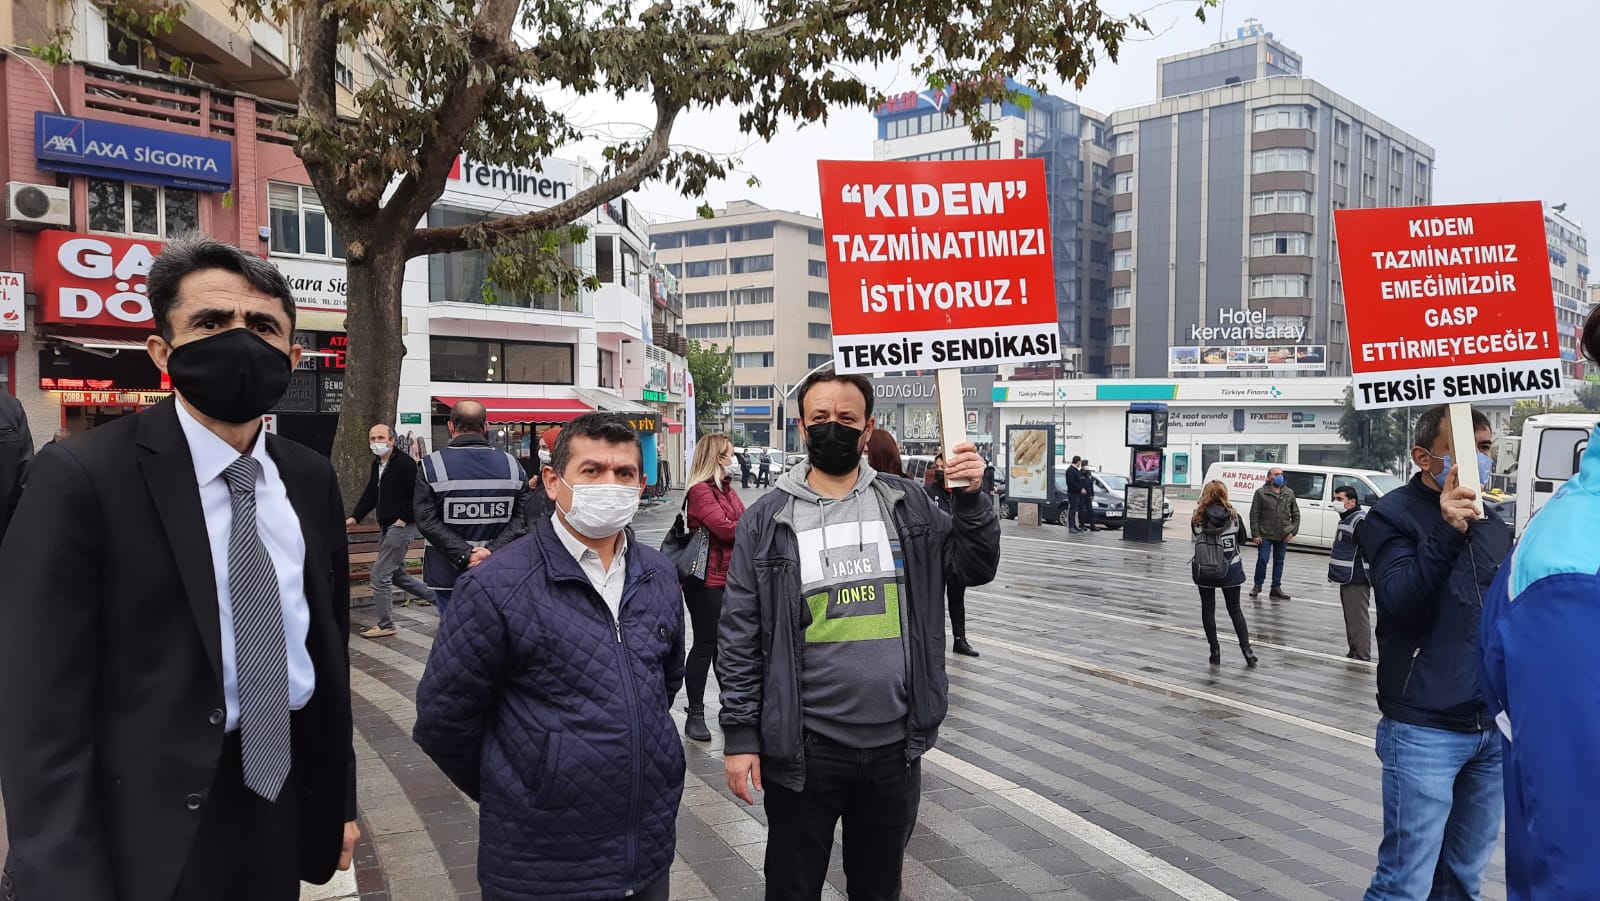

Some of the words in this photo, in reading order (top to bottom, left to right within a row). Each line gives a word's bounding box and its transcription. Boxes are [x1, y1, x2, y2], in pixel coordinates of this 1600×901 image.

[44, 135, 77, 152] AXA
[85, 140, 128, 159] AXA
[134, 147, 218, 173] SİGORTA
[463, 154, 566, 200] feminen
[1408, 217, 1474, 238] KIDEM
[832, 226, 1045, 262] TAZMİNATIMIZI
[1371, 244, 1518, 270] TAZMİNATIMIZ
[0, 275, 19, 286] TA
[1381, 270, 1516, 300] EMEĞİMİZDİR
[860, 277, 1012, 312] İSTİYORUZ
[1219, 307, 1266, 324] Hotel
[1424, 306, 1478, 327] GASP
[1191, 324, 1305, 343] kervansaray
[1361, 328, 1538, 362] ETTİRMEYECEĞİZ
[838, 337, 923, 368] TEKSİF
[932, 331, 1057, 362] SENDİKASI
[1221, 388, 1245, 397] Türkiye
[1247, 388, 1269, 396] Finans
[1359, 374, 1435, 404] TEKSİF
[1443, 367, 1561, 397] SENDİKASI
[832, 558, 873, 578] JACK&
[836, 585, 876, 605] JONES
